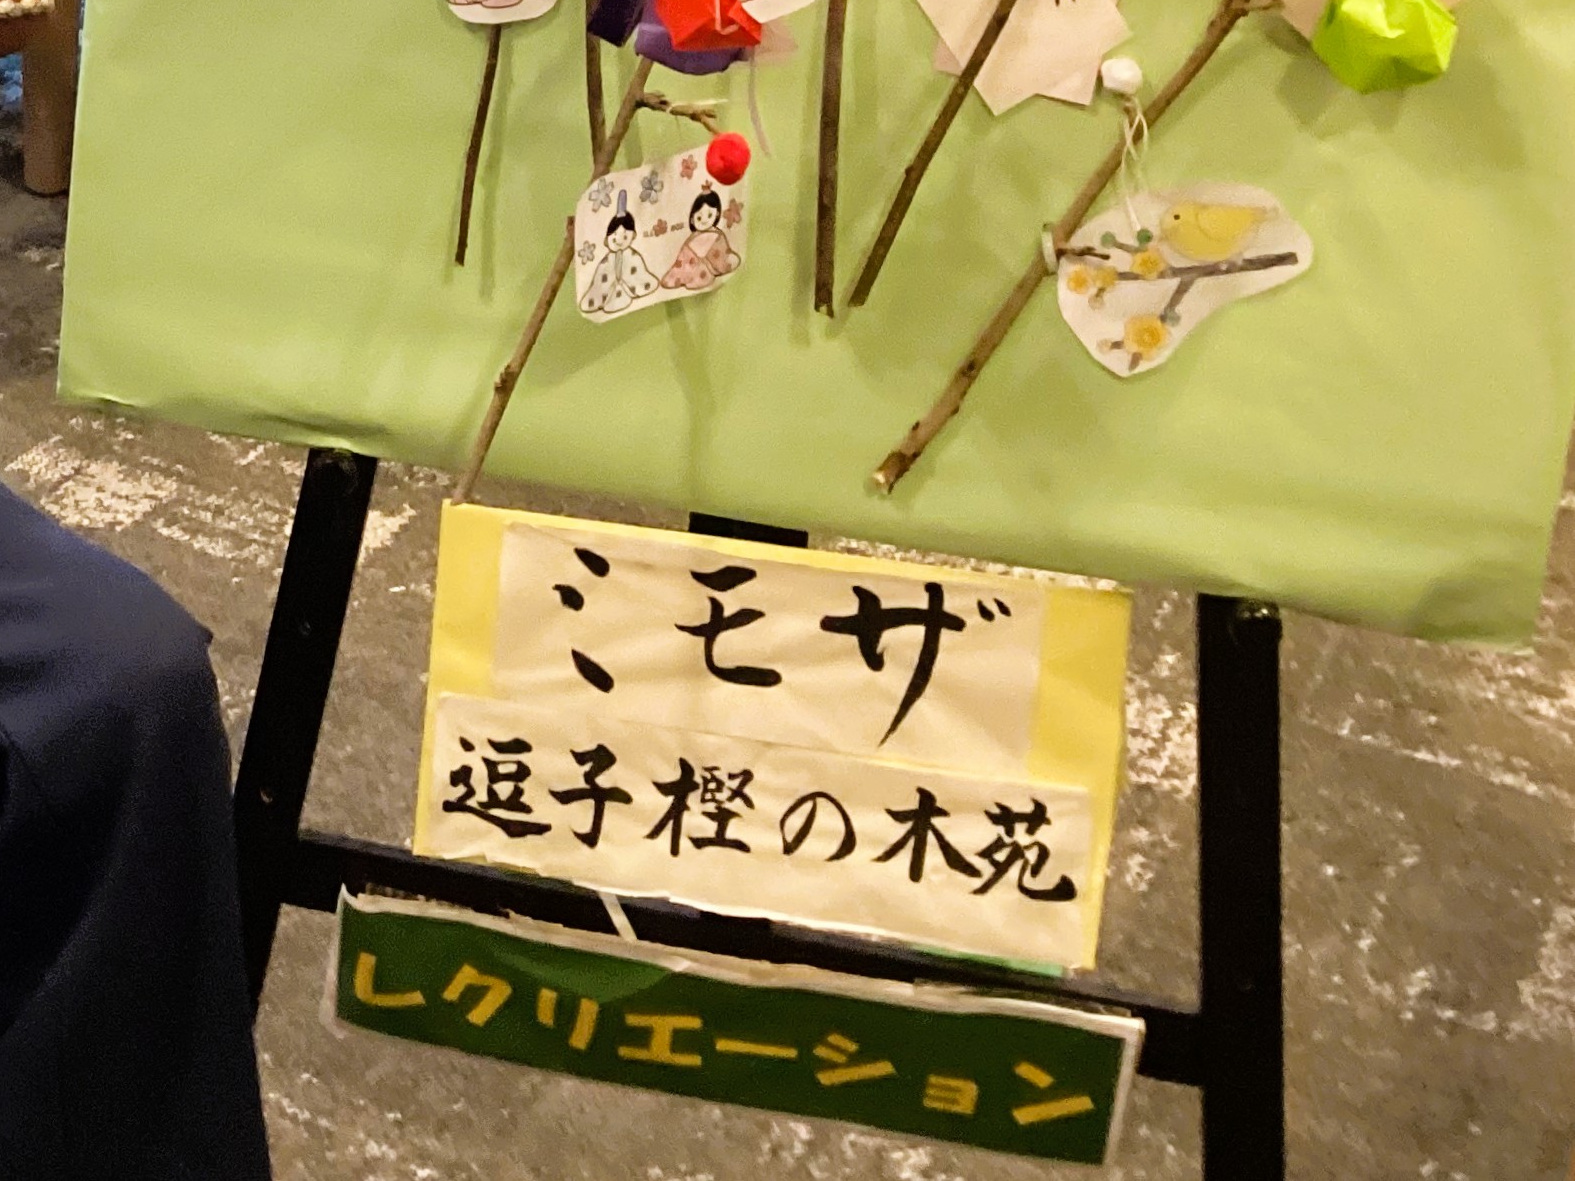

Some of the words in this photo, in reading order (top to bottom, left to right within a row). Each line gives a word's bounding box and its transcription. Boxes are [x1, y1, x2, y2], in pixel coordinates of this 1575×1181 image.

[552, 547, 1012, 746] ミモザ
[441, 735, 1078, 902] 逗子樫の木苑
[352, 951, 1096, 1127] レクリエーション
